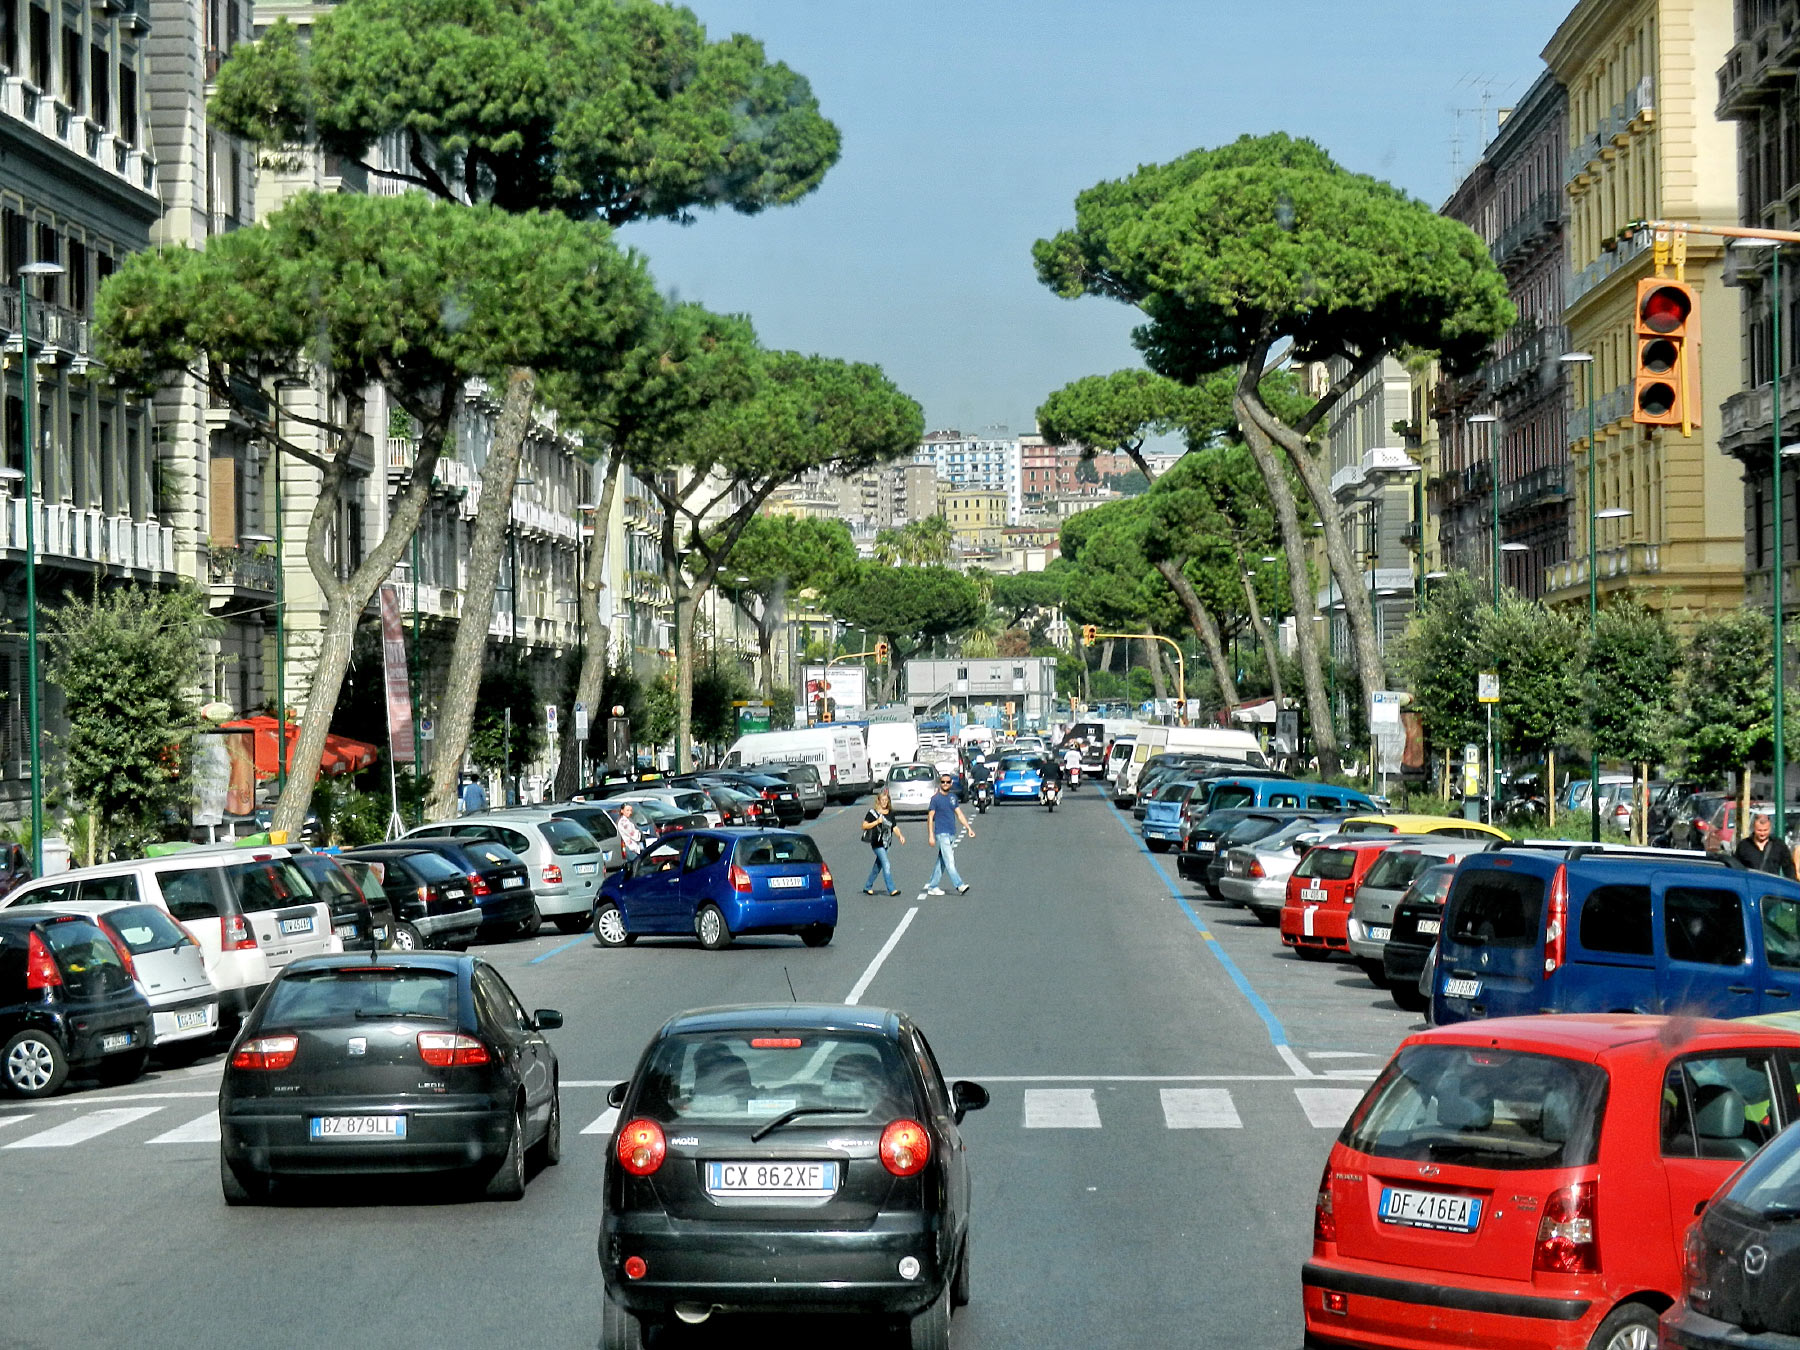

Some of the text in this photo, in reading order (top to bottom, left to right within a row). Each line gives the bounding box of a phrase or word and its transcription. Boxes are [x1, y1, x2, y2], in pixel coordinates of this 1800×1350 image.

[1468, 751, 1476, 760] P
[323, 1117, 395, 1133] BZ 879LL
[724, 1166, 820, 1187] CX 862XF
[1390, 1193, 1467, 1223] DF 416EA
